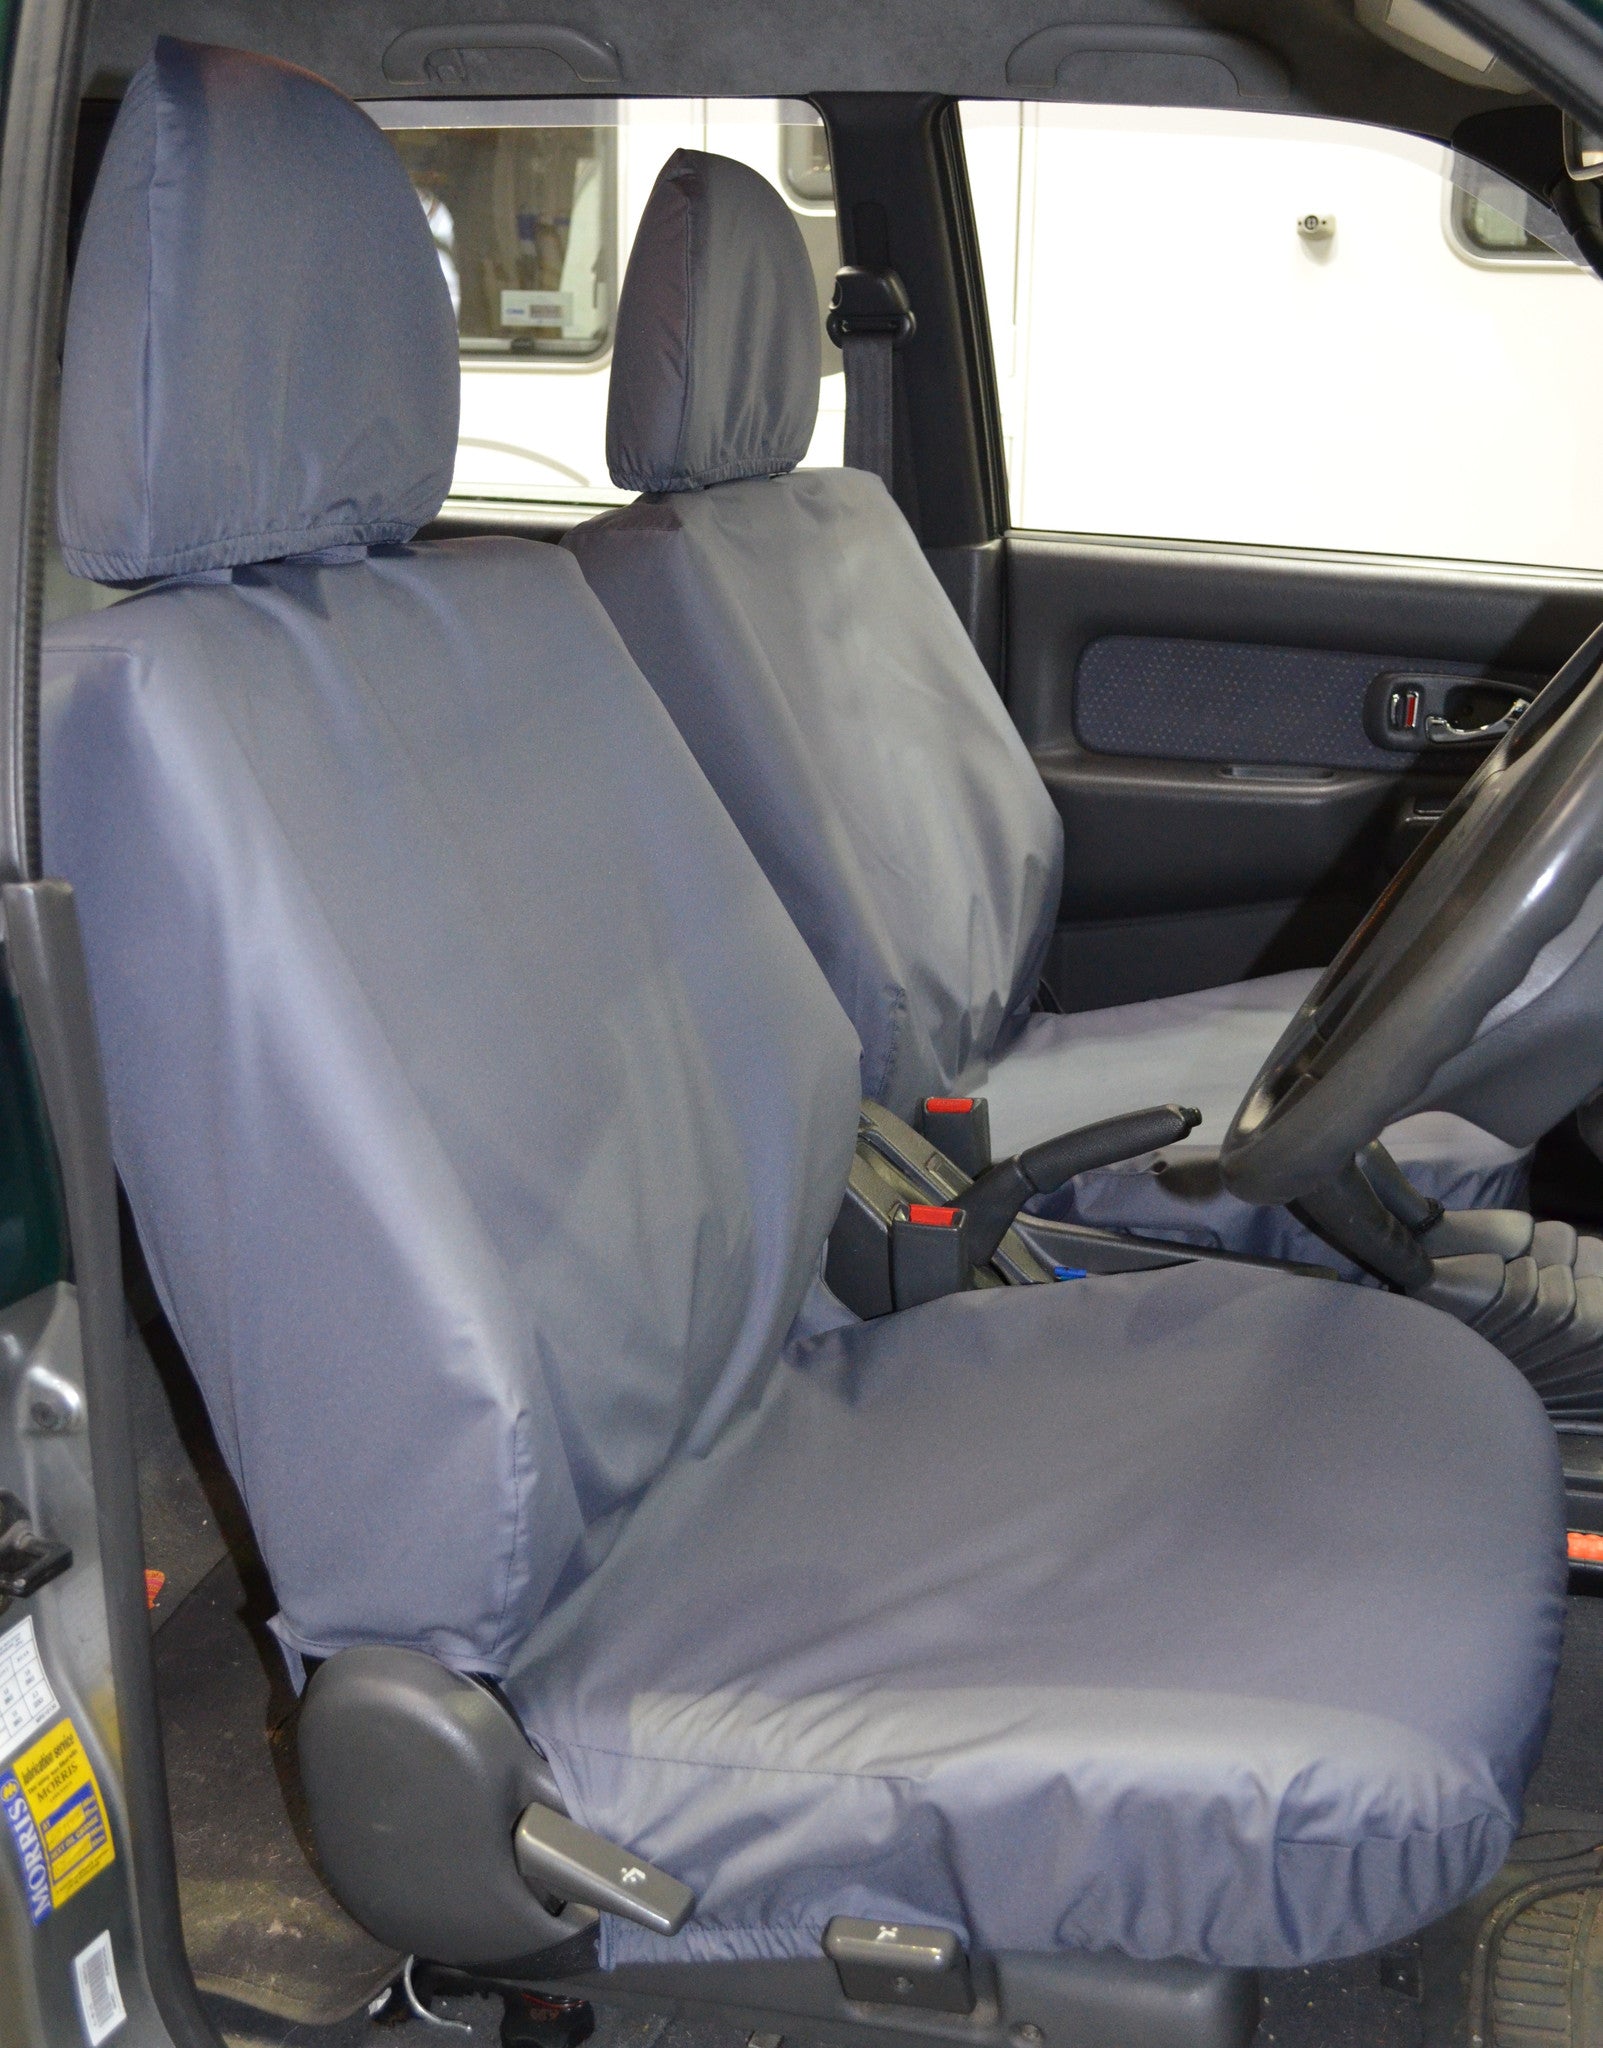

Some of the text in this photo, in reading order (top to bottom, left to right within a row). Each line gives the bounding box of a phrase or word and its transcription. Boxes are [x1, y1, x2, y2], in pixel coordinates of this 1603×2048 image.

[53, 1734, 75, 1758] service
[37, 1762, 78, 1802] MORRIS
[8, 1797, 51, 1918] MORRIS
